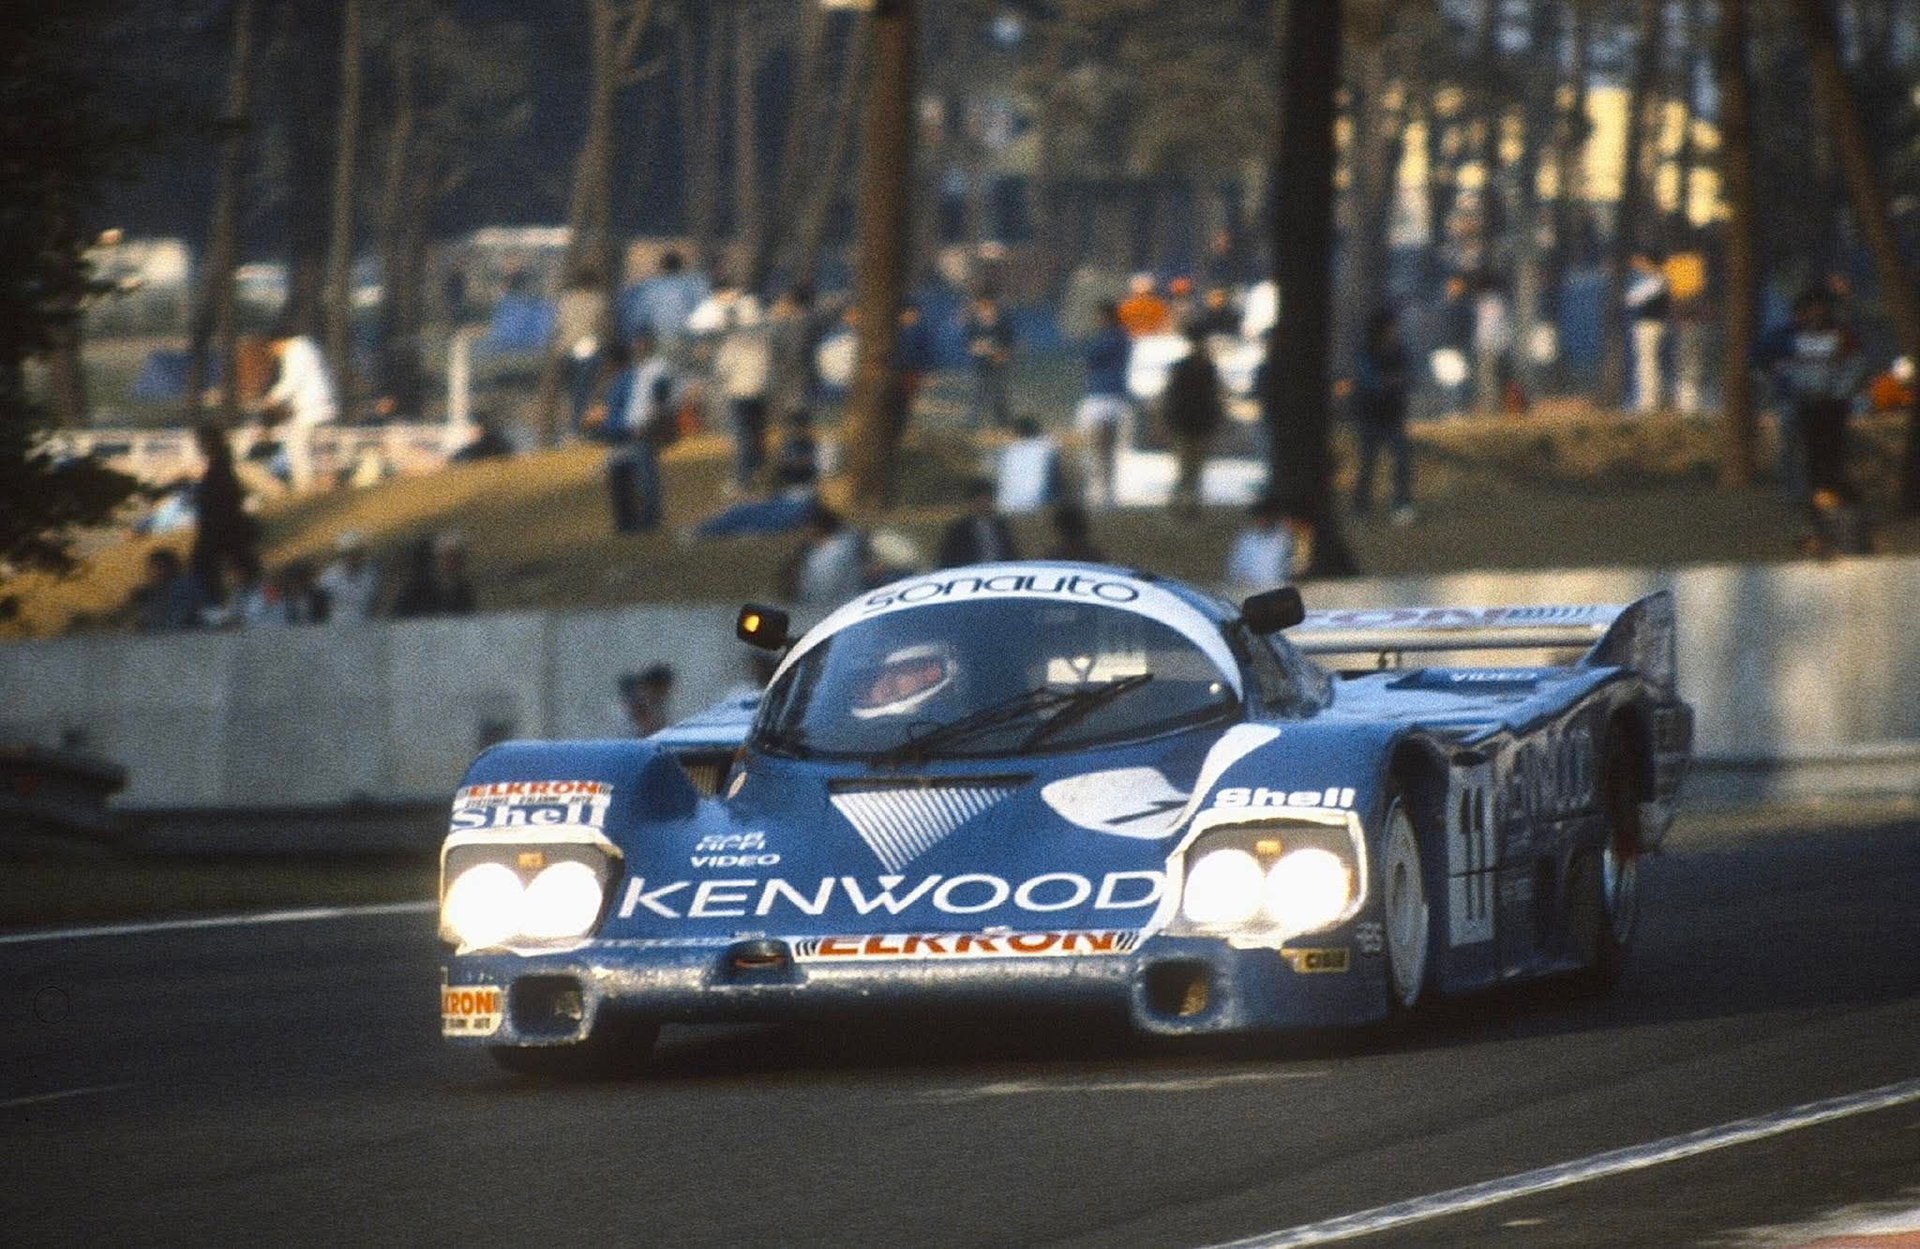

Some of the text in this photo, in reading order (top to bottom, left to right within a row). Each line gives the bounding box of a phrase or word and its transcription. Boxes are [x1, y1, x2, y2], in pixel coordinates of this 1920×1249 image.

[863, 574, 1139, 614] sonauto
[469, 781, 601, 797] ELKRON
[1214, 787, 1356, 808] Shell
[450, 801, 607, 829] Shell
[690, 853, 781, 868] VIDEO
[618, 872, 1168, 919] KENWOOD
[818, 931, 1118, 956] ELKRON
